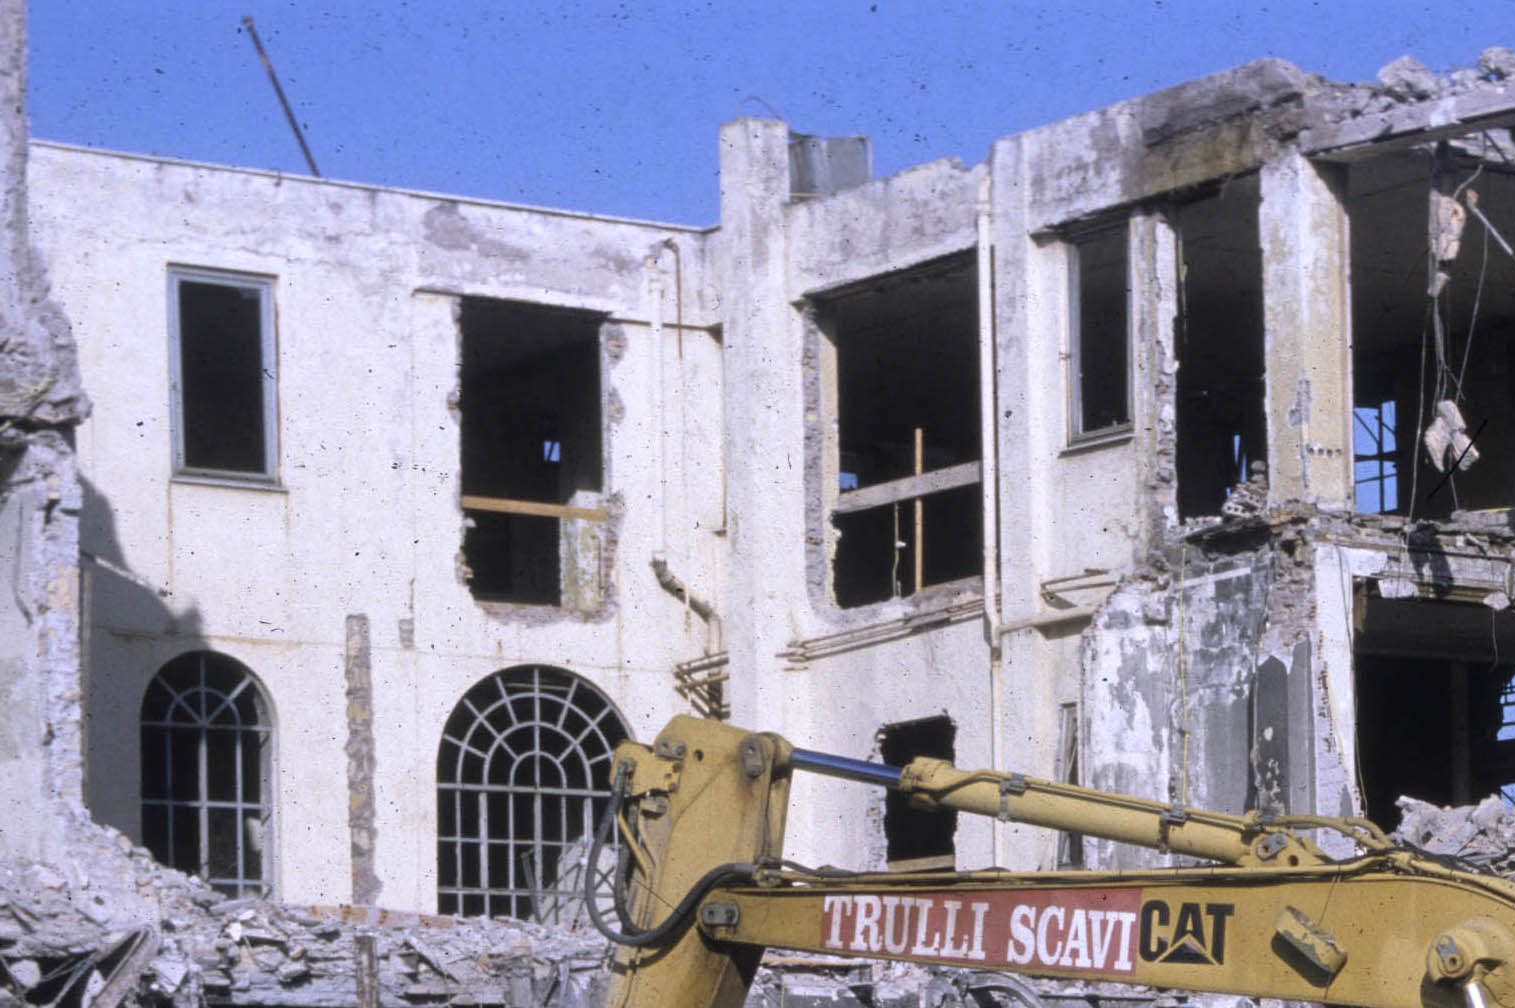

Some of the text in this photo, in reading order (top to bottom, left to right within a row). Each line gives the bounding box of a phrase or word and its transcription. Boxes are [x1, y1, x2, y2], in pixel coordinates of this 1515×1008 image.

[823, 895, 1137, 971] TRULLI SCAVI
[1139, 899, 1235, 966] CAT
